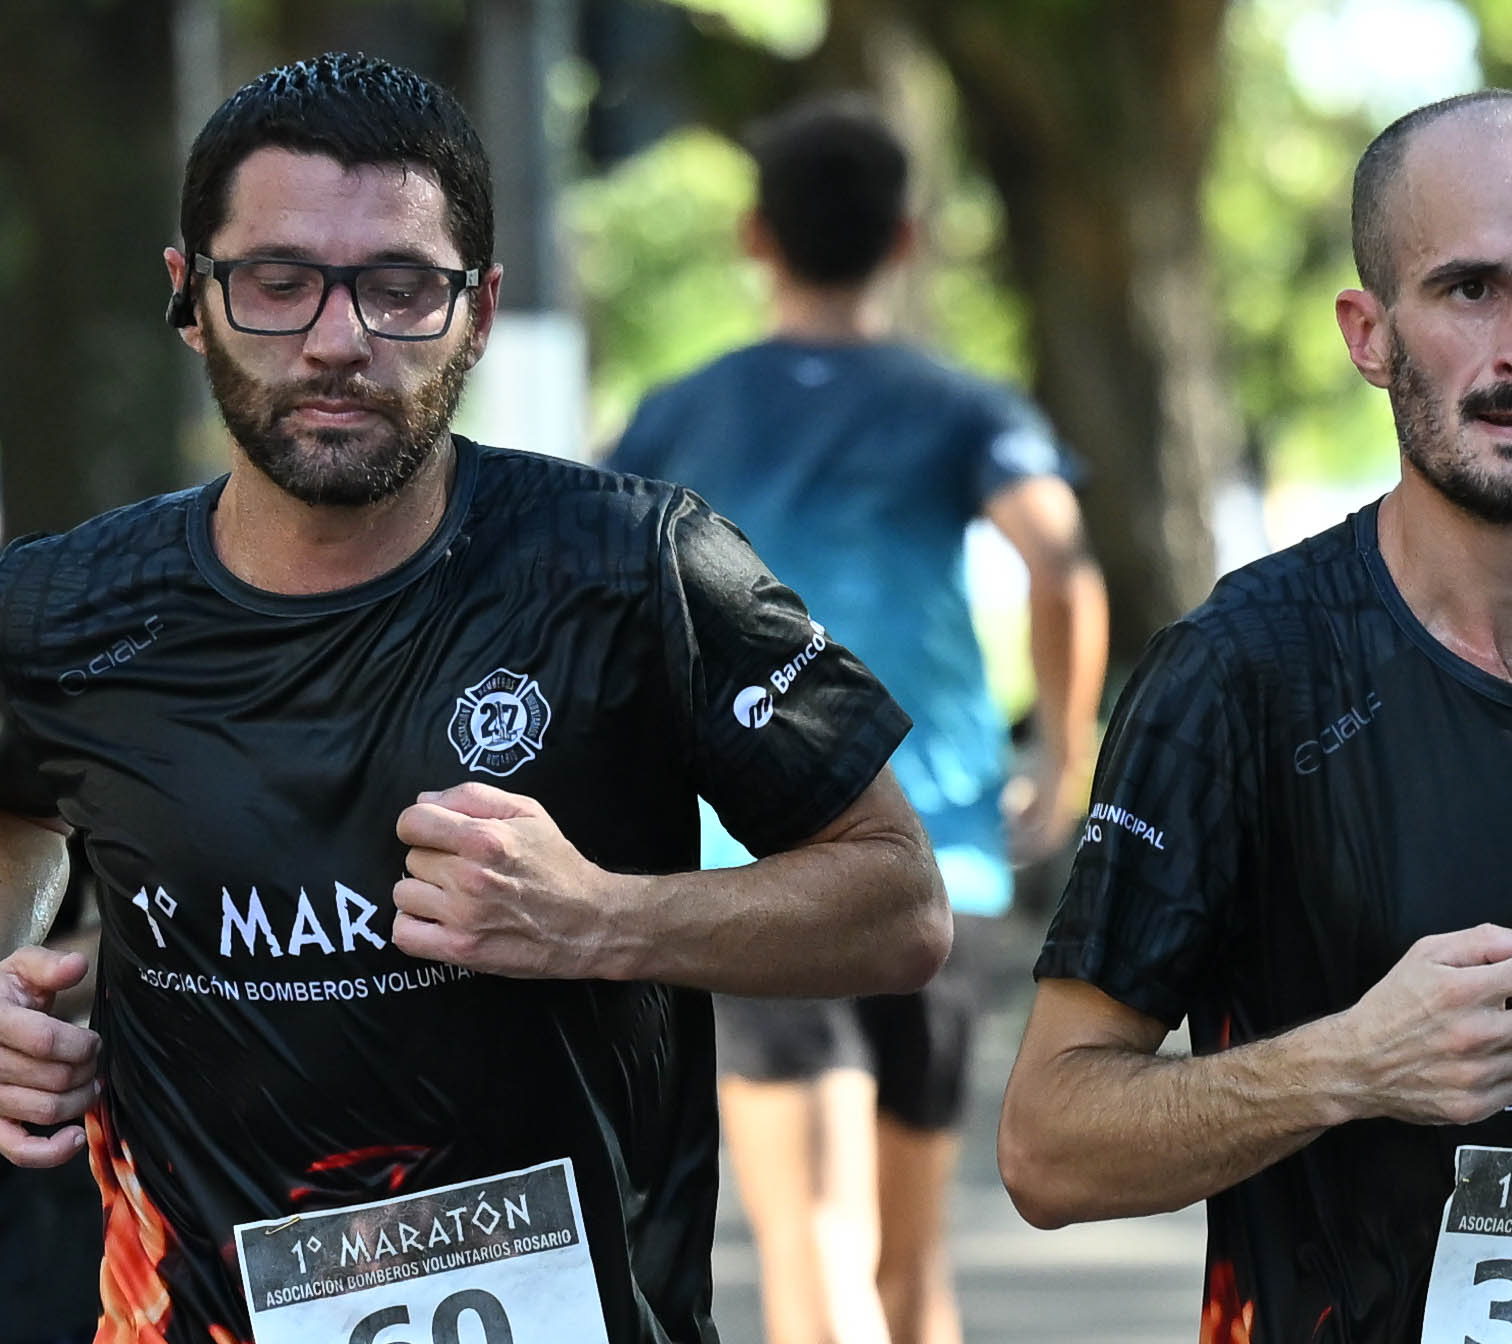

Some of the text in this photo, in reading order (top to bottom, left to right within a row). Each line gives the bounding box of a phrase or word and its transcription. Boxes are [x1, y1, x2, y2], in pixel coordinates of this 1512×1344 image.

[770, 633, 826, 694] Banco
[479, 702, 519, 739] 27
[244, 977, 369, 1002] BOMBEROS
[373, 963, 476, 995] VOLUNTA
[340, 1190, 531, 1268] MARATÓN
[265, 1228, 572, 1308] ASOCIACIÓN BOMBEROS VOLUNTARIOS ROSARIO
